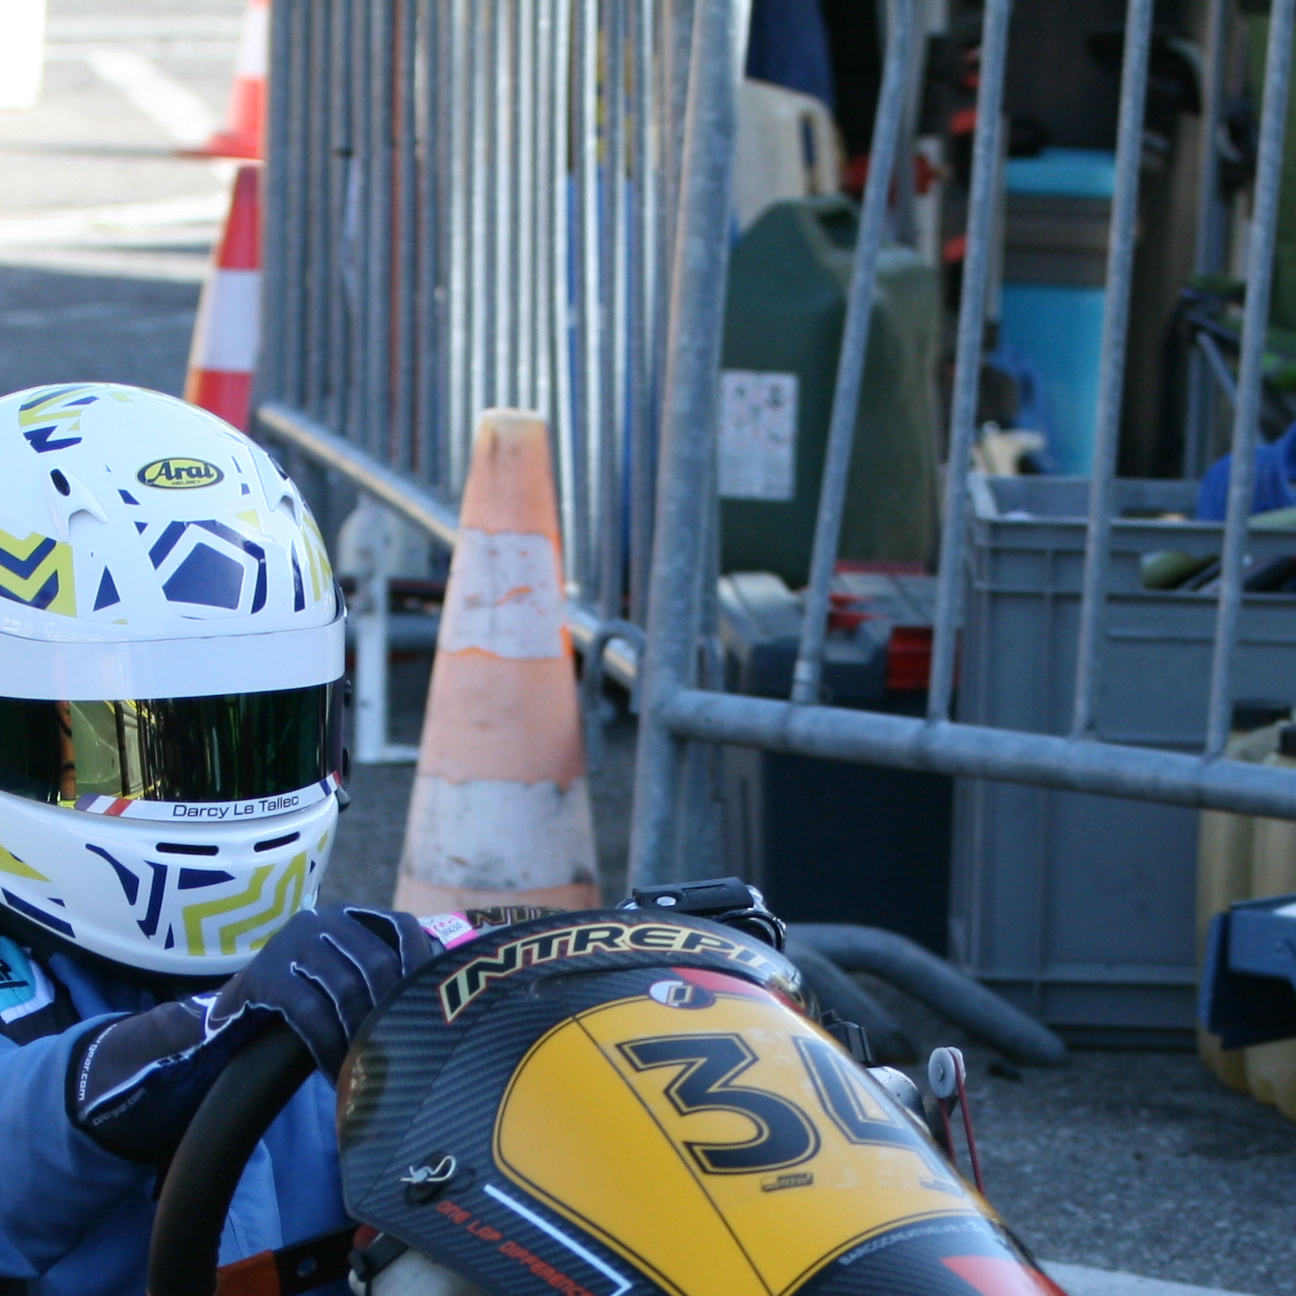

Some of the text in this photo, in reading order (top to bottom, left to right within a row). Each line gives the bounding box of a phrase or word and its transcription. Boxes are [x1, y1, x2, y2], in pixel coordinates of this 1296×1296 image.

[145, 460, 215, 485] Arai
[172, 795, 301, 819] Darcy Le Tallec
[435, 1199, 473, 1225] ONE
[466, 1219, 503, 1242] LAP
